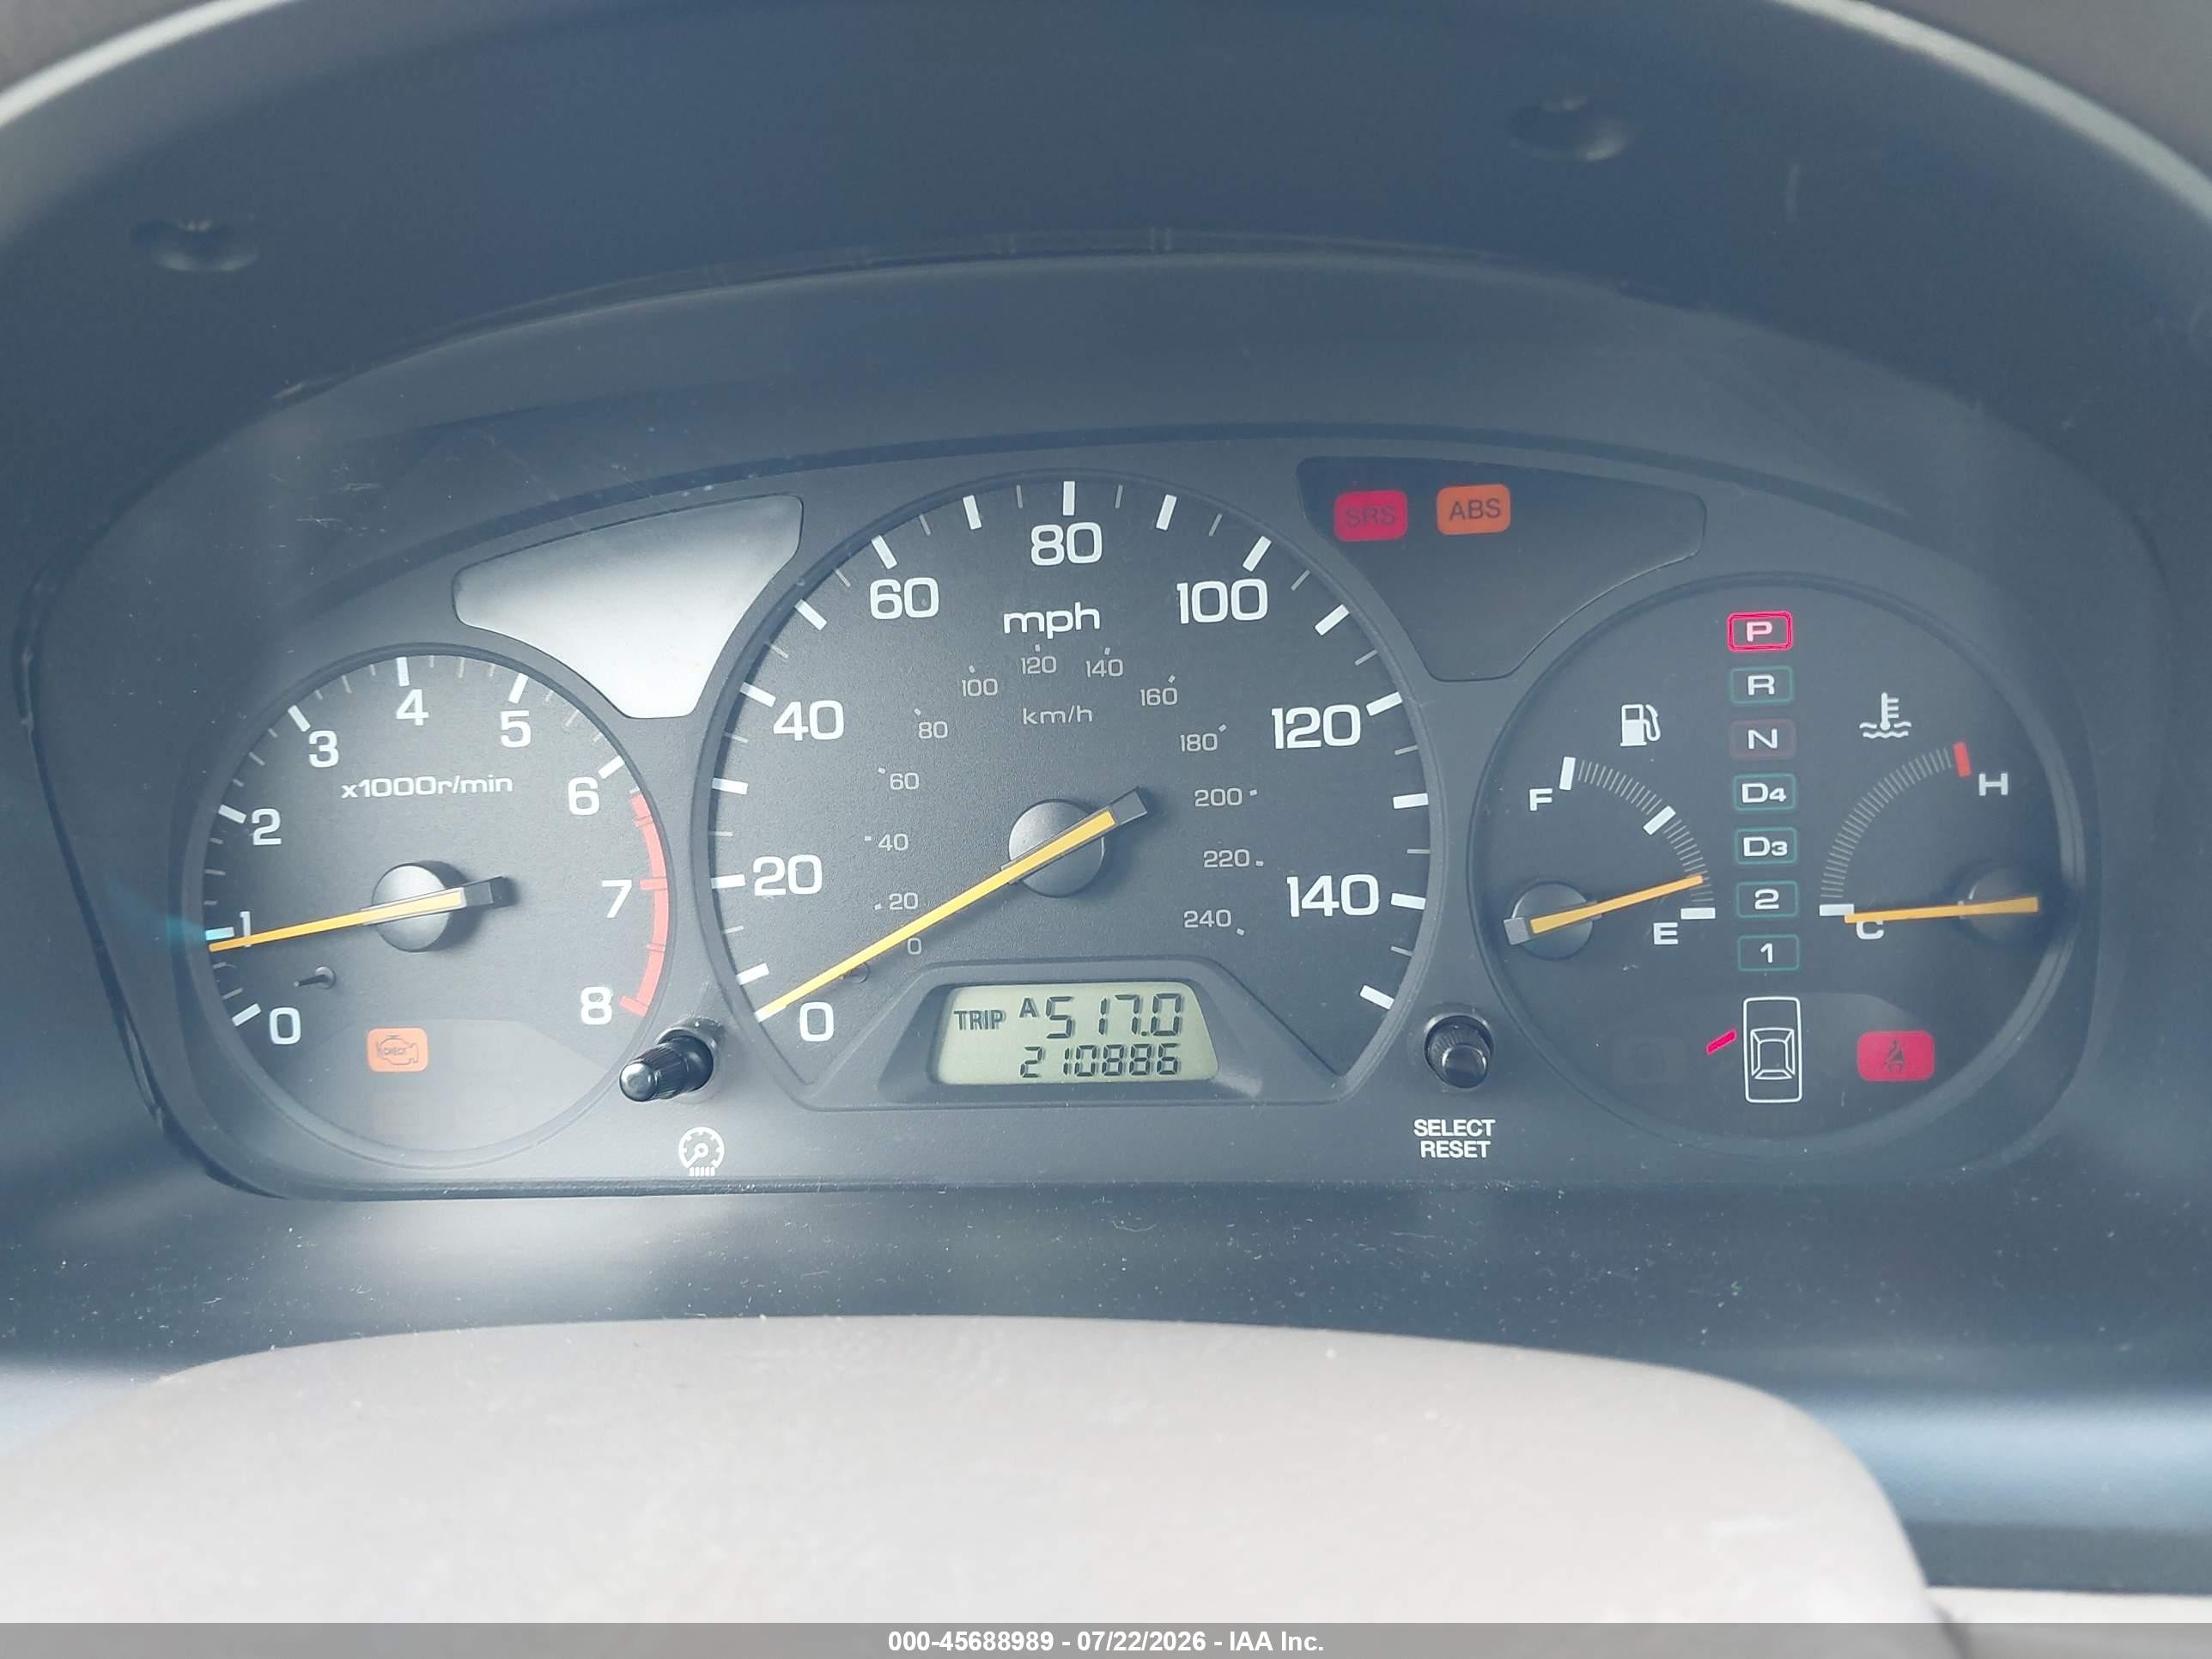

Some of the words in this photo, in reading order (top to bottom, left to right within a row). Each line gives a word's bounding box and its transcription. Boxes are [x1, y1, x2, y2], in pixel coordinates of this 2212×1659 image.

[1345, 506, 1396, 528] SRS
[1449, 498, 1502, 521] ABS
[1030, 521, 1103, 566] 80
[869, 577, 939, 620] 60
[1176, 578, 1268, 624] 100
[1003, 601, 1100, 640] mph
[1747, 621, 1773, 642] P
[1020, 655, 1057, 675] 120
[1085, 659, 1123, 678] 140
[961, 678, 999, 697] 100
[1747, 674, 1775, 696] R
[396, 689, 429, 726] 4
[1139, 687, 1178, 707] 160
[773, 699, 844, 741] 40
[1023, 705, 1093, 725] km/h
[501, 710, 532, 748] 5
[918, 720, 948, 739] 80
[1271, 704, 1361, 750] 120
[308, 730, 340, 768] 3
[1180, 732, 1218, 752] 180
[1747, 728, 1778, 750] N
[341, 774, 514, 799] x1000r/min
[890, 772, 920, 791] 60
[1741, 782, 1787, 803] D4
[1978, 772, 2008, 796] H
[568, 776, 601, 816] 6
[1194, 787, 1243, 807] 200
[1529, 787, 1553, 811] F
[252, 808, 282, 846] 2
[878, 833, 909, 852] 40
[1743, 836, 1788, 857] D3
[1203, 848, 1250, 868] 220
[752, 854, 823, 898] 20
[601, 879, 633, 919] 7
[889, 892, 919, 911] 20
[1286, 873, 1380, 918] 140
[1754, 889, 1780, 910] 2
[240, 910, 252, 948] 1
[1183, 908, 1231, 928] 240
[1653, 921, 1679, 945] E
[1856, 921, 1885, 940] C
[906, 937, 923, 955] 0
[1760, 943, 1773, 963] 1
[580, 986, 614, 1025] 8
[953, 1009, 1005, 1031] TRIP
[1018, 997, 1038, 1018] A
[1045, 993, 1182, 1039] 517.0
[269, 1006, 301, 1045] 0
[799, 1001, 835, 1042] 0
[1020, 1042, 1181, 1079] 210886
[1413, 1118, 1496, 1137] SELECT
[1420, 1139, 1492, 1158] RESET
